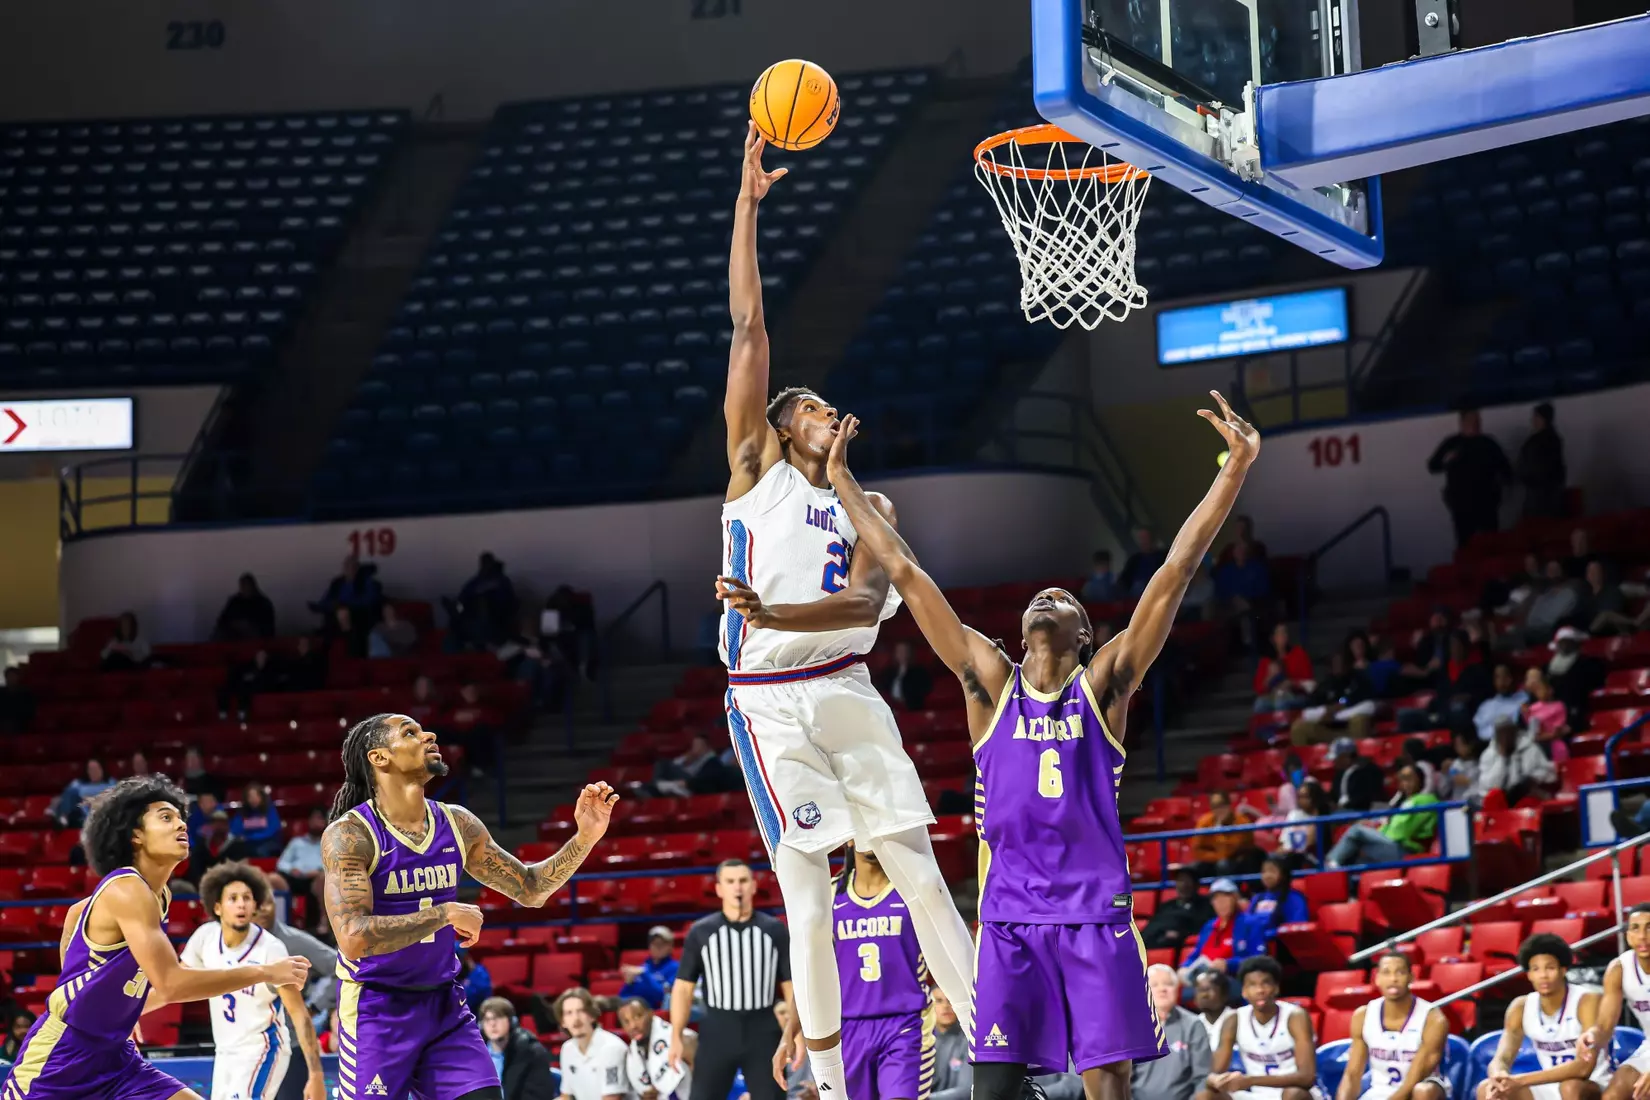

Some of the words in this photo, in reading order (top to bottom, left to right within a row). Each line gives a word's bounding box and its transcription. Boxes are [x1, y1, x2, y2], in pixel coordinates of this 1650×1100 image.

[166, 20, 226, 50] 230
[1307, 434, 1362, 468] 101
[347, 528, 397, 559] 119
[1037, 748, 1064, 798] 6
[384, 863, 457, 895] ALCORN
[837, 915, 903, 940] ALCORN
[857, 942, 881, 982] 3
[222, 993, 236, 1023] 3
